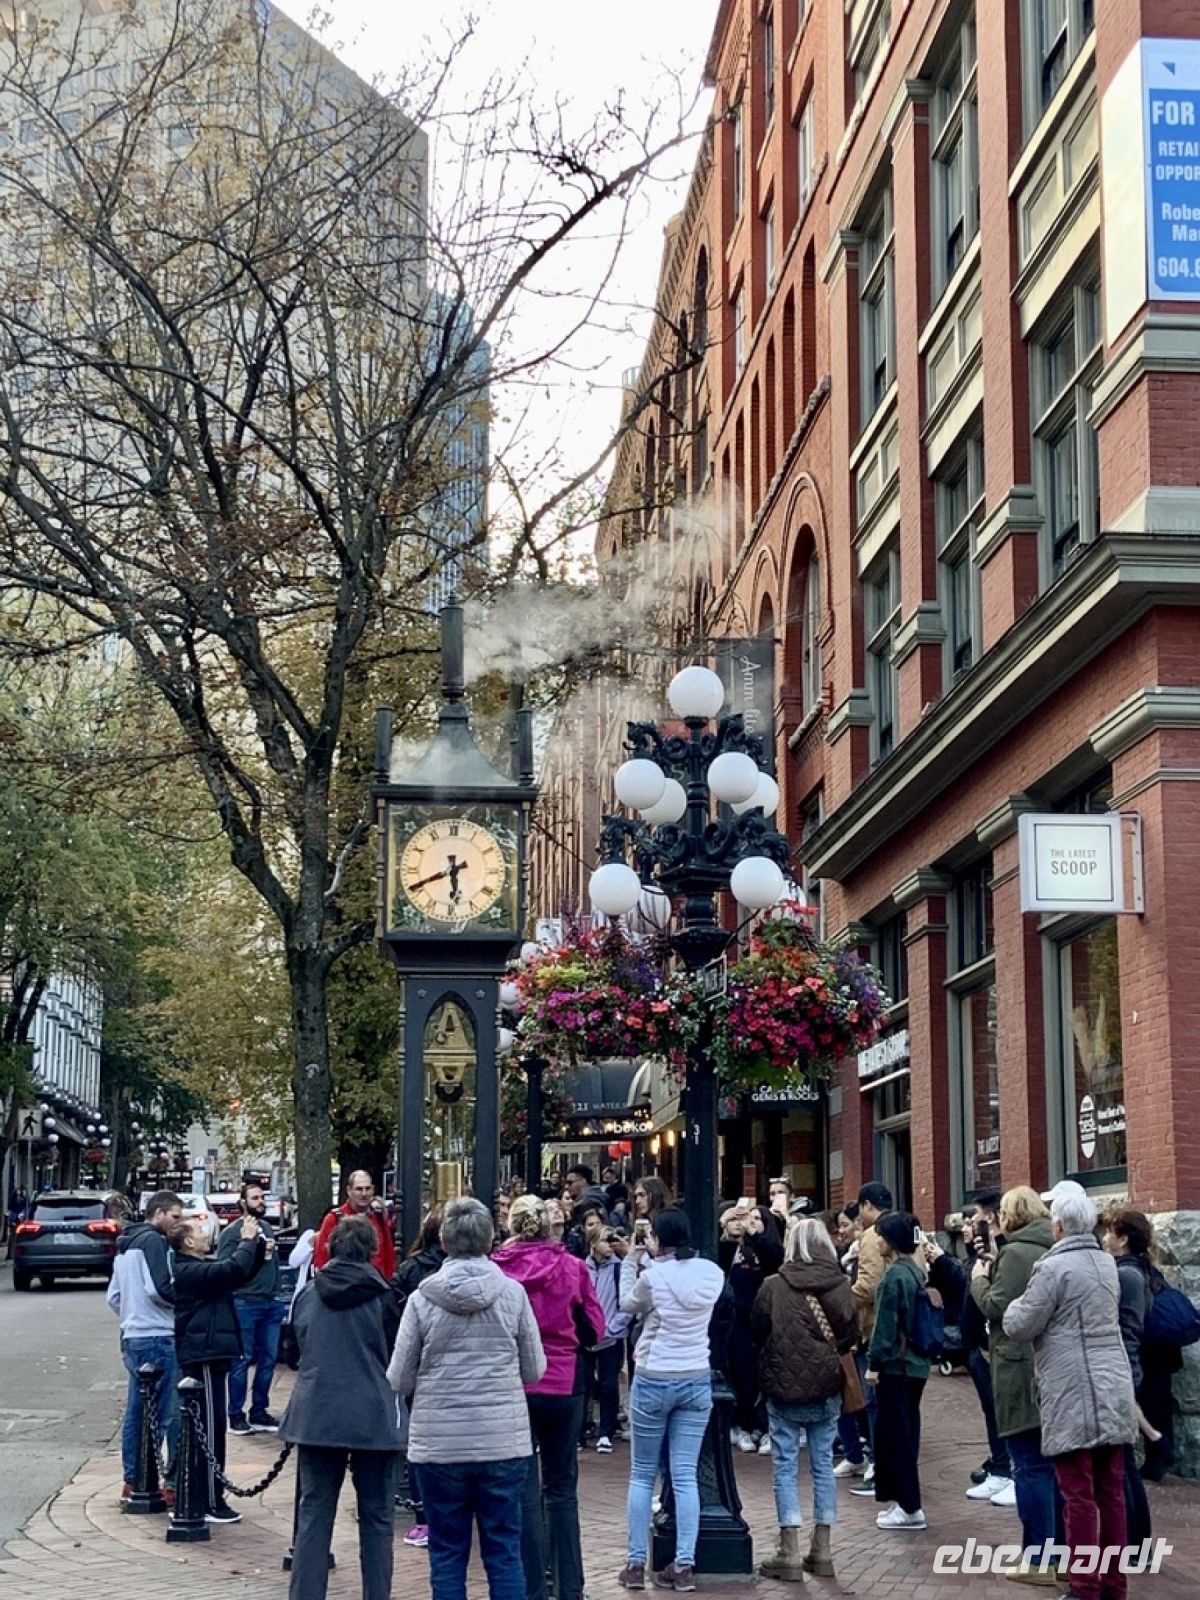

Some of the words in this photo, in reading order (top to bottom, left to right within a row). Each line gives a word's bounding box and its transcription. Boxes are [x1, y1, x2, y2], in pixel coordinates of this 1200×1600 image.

[1152, 101, 1195, 126] FOR
[740, 655, 762, 736] Ammlite
[1051, 849, 1064, 858] THE
[1068, 849, 1096, 858] LATEST
[1051, 860, 1097, 876] SCOOP
